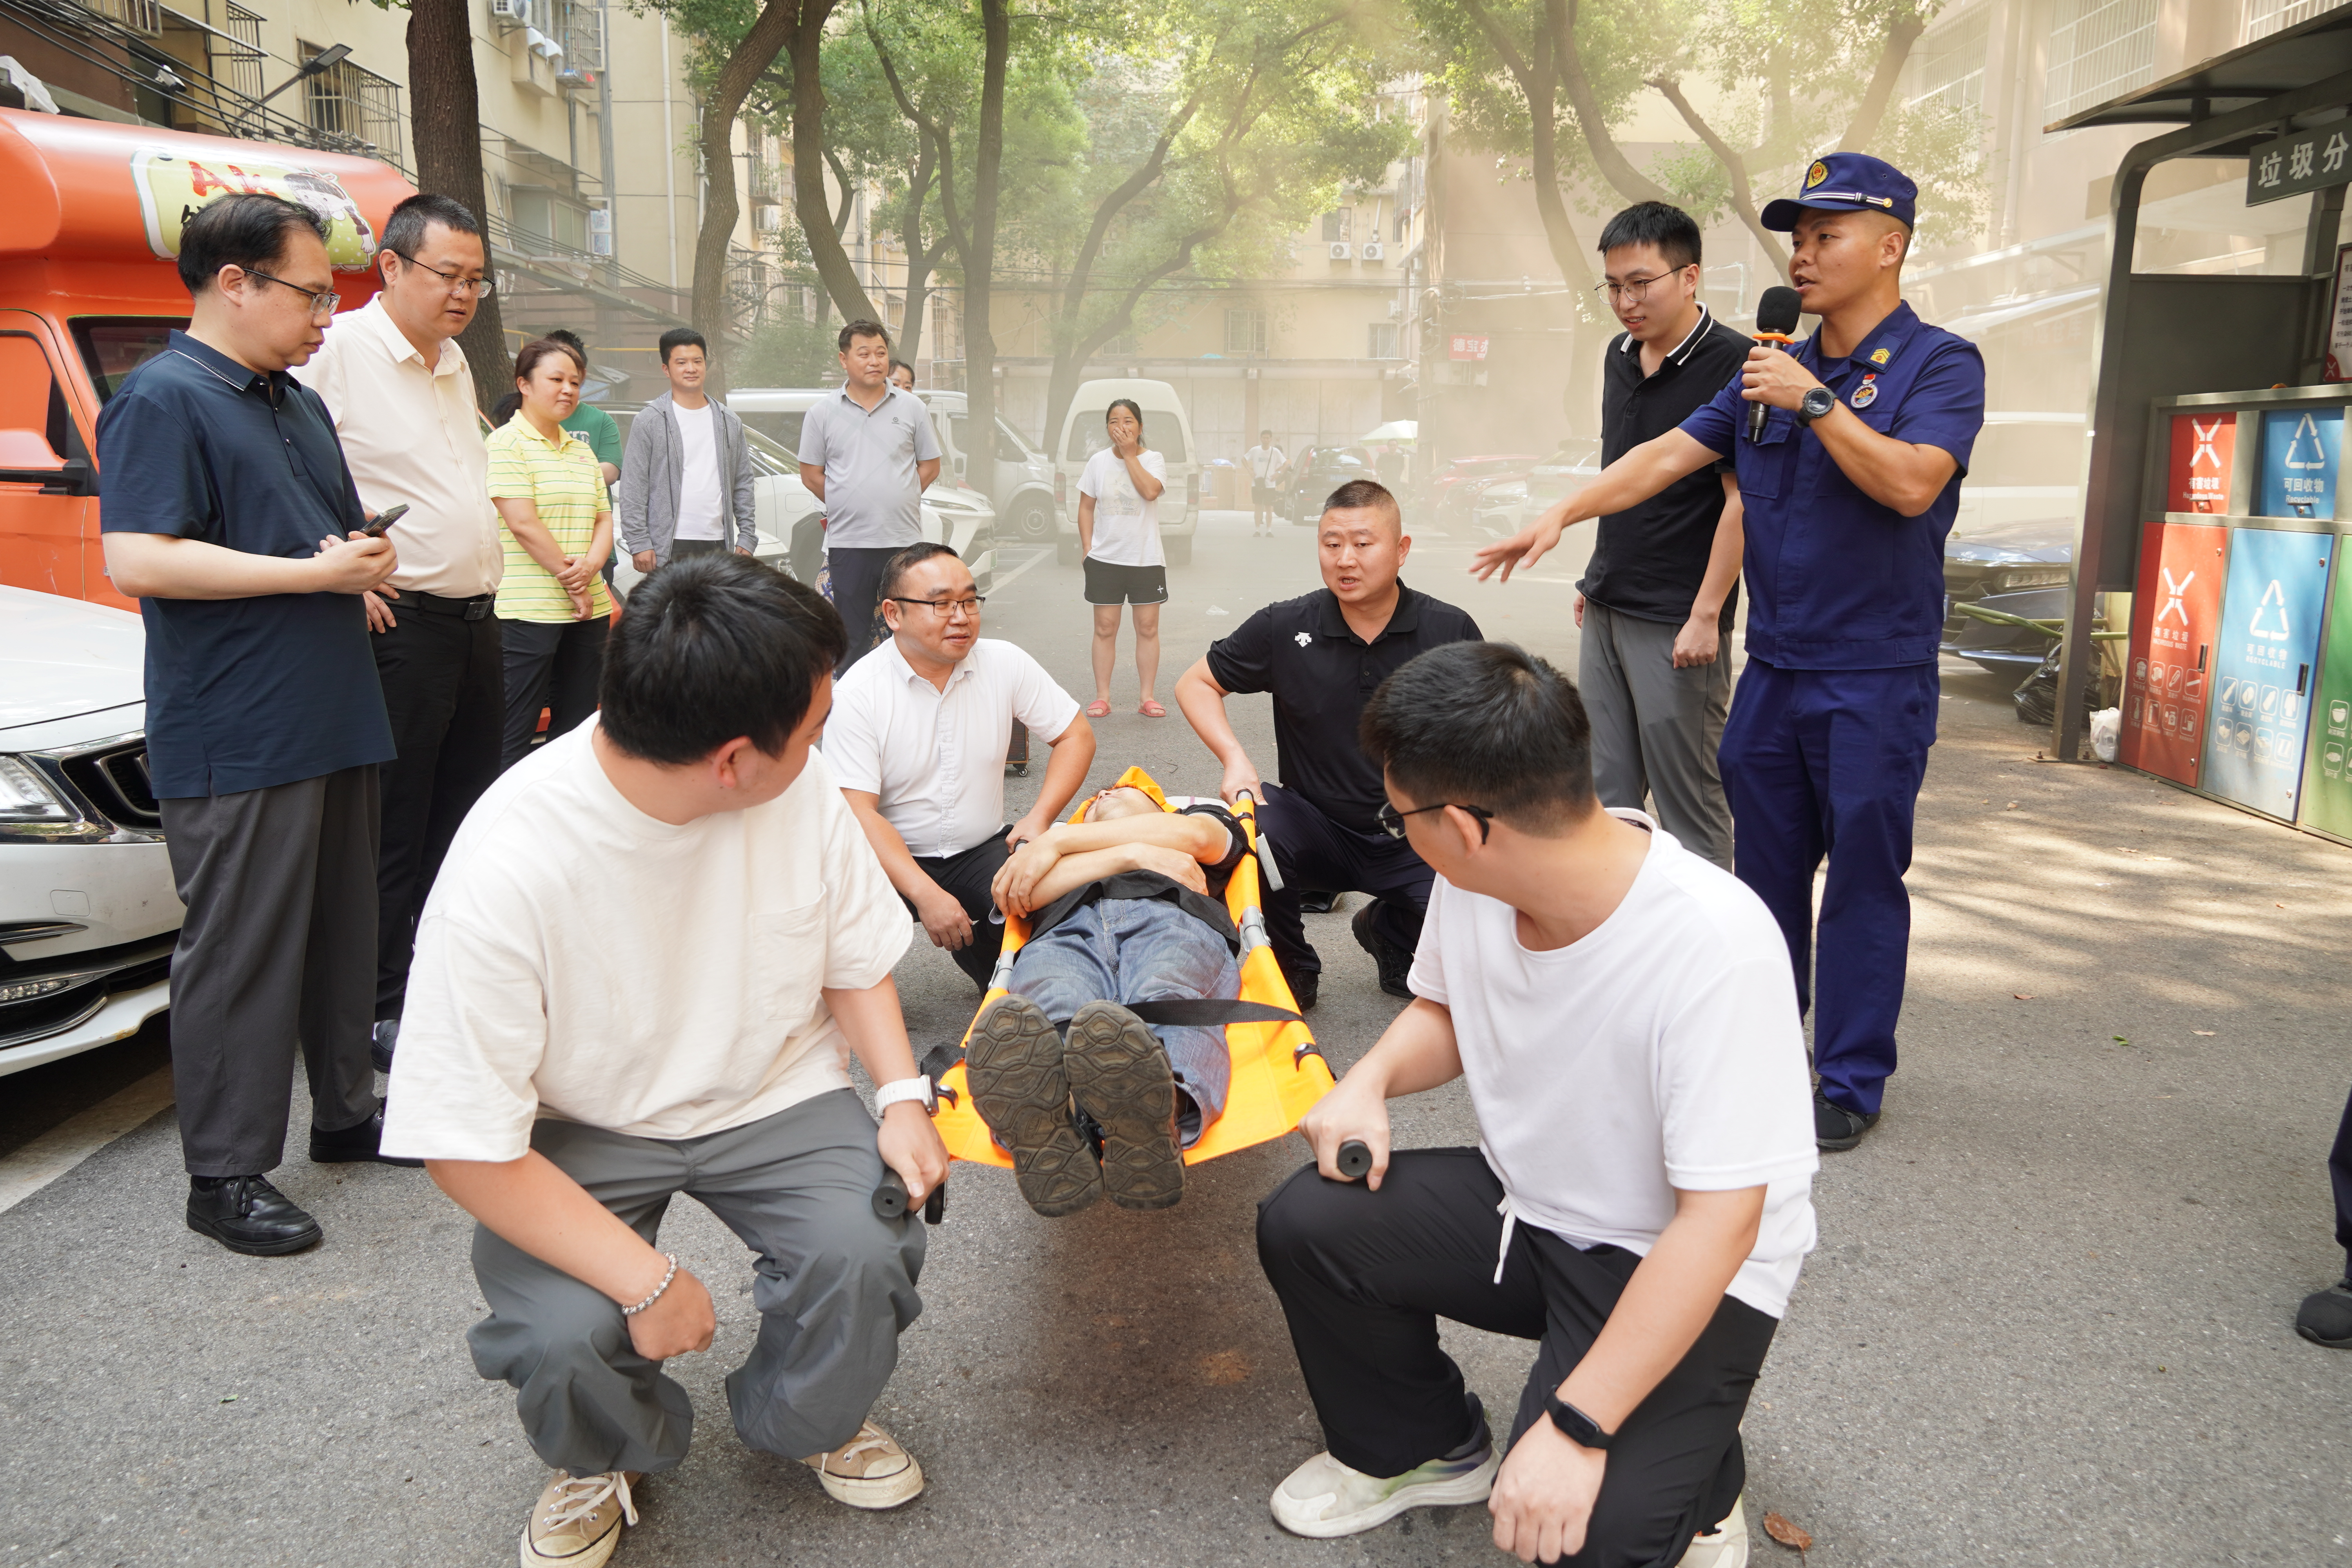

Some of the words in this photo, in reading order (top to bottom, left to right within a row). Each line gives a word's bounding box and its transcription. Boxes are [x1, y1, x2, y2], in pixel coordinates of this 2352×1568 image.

[2258, 131, 2349, 188] 垃圾分
[2188, 477, 2219, 490] 有害垃圾
[2283, 477, 2324, 493] 可回收物
[2208, 492, 2224, 500] Waste
[2285, 494, 2320, 504] Recyclable
[2154, 626, 2189, 642] 有害垃圾
[2175, 642, 2187, 650] WASTE
[2246, 643, 2288, 661] 可回收物
[2245, 655, 2286, 669] RECYCLABLE
